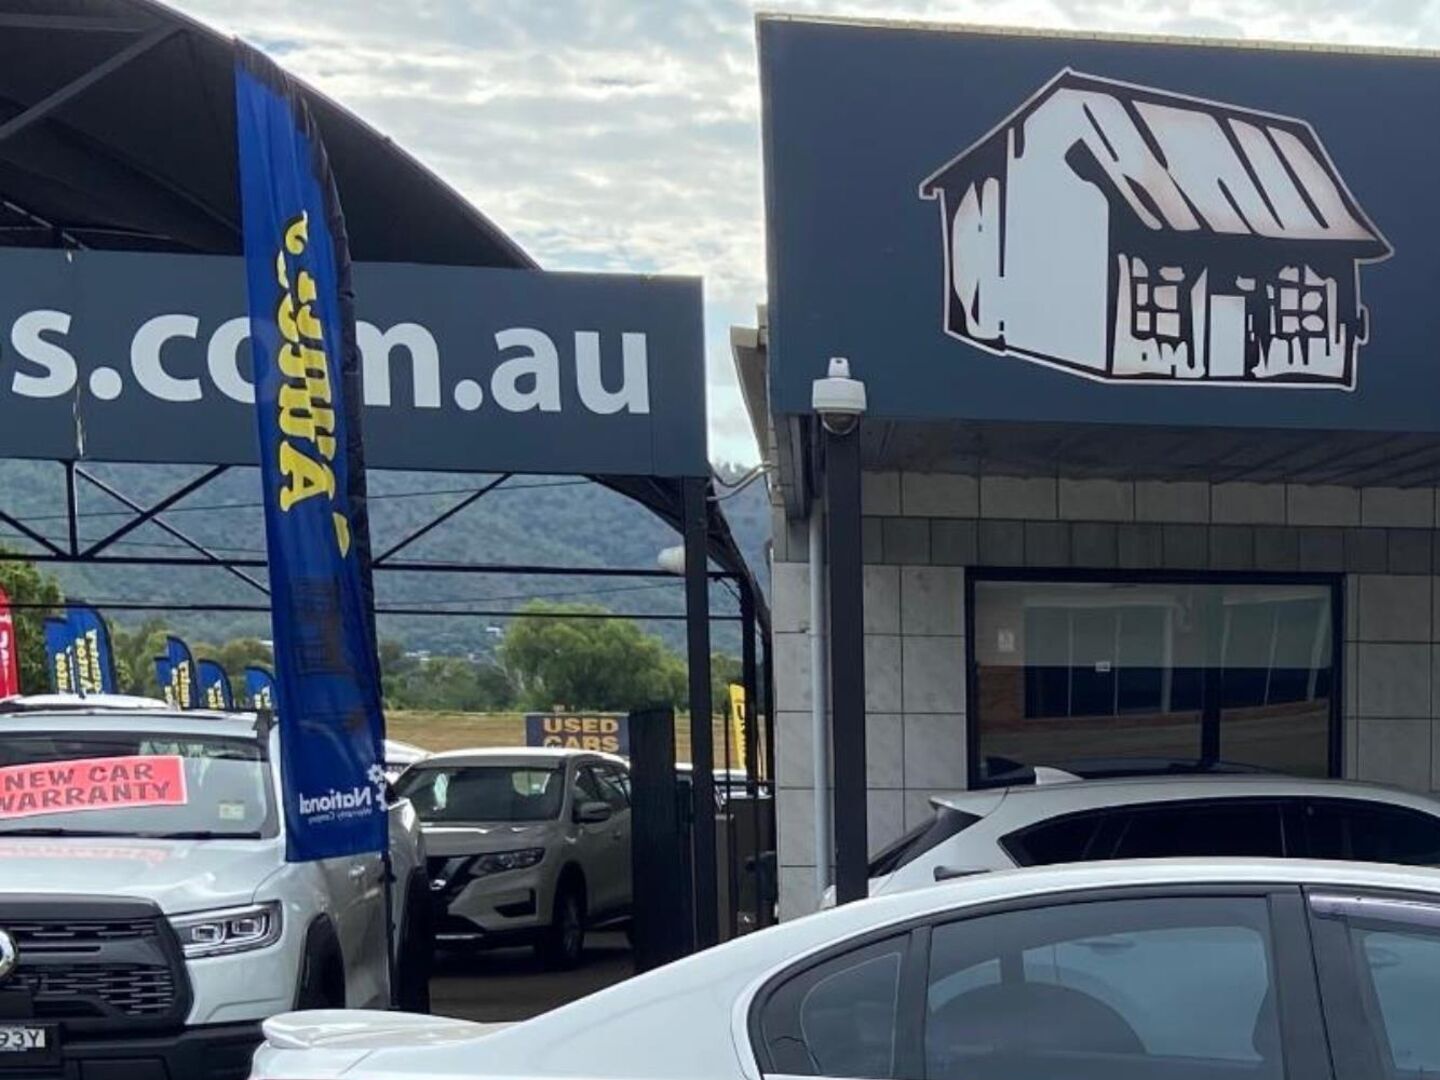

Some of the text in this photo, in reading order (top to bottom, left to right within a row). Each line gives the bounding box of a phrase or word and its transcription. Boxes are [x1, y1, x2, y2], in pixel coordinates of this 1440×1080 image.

[543, 717, 619, 734] USED
[544, 735, 620, 752] CARS
[5, 763, 153, 792] NEW CAR
[0, 782, 170, 812] WARRANTY
